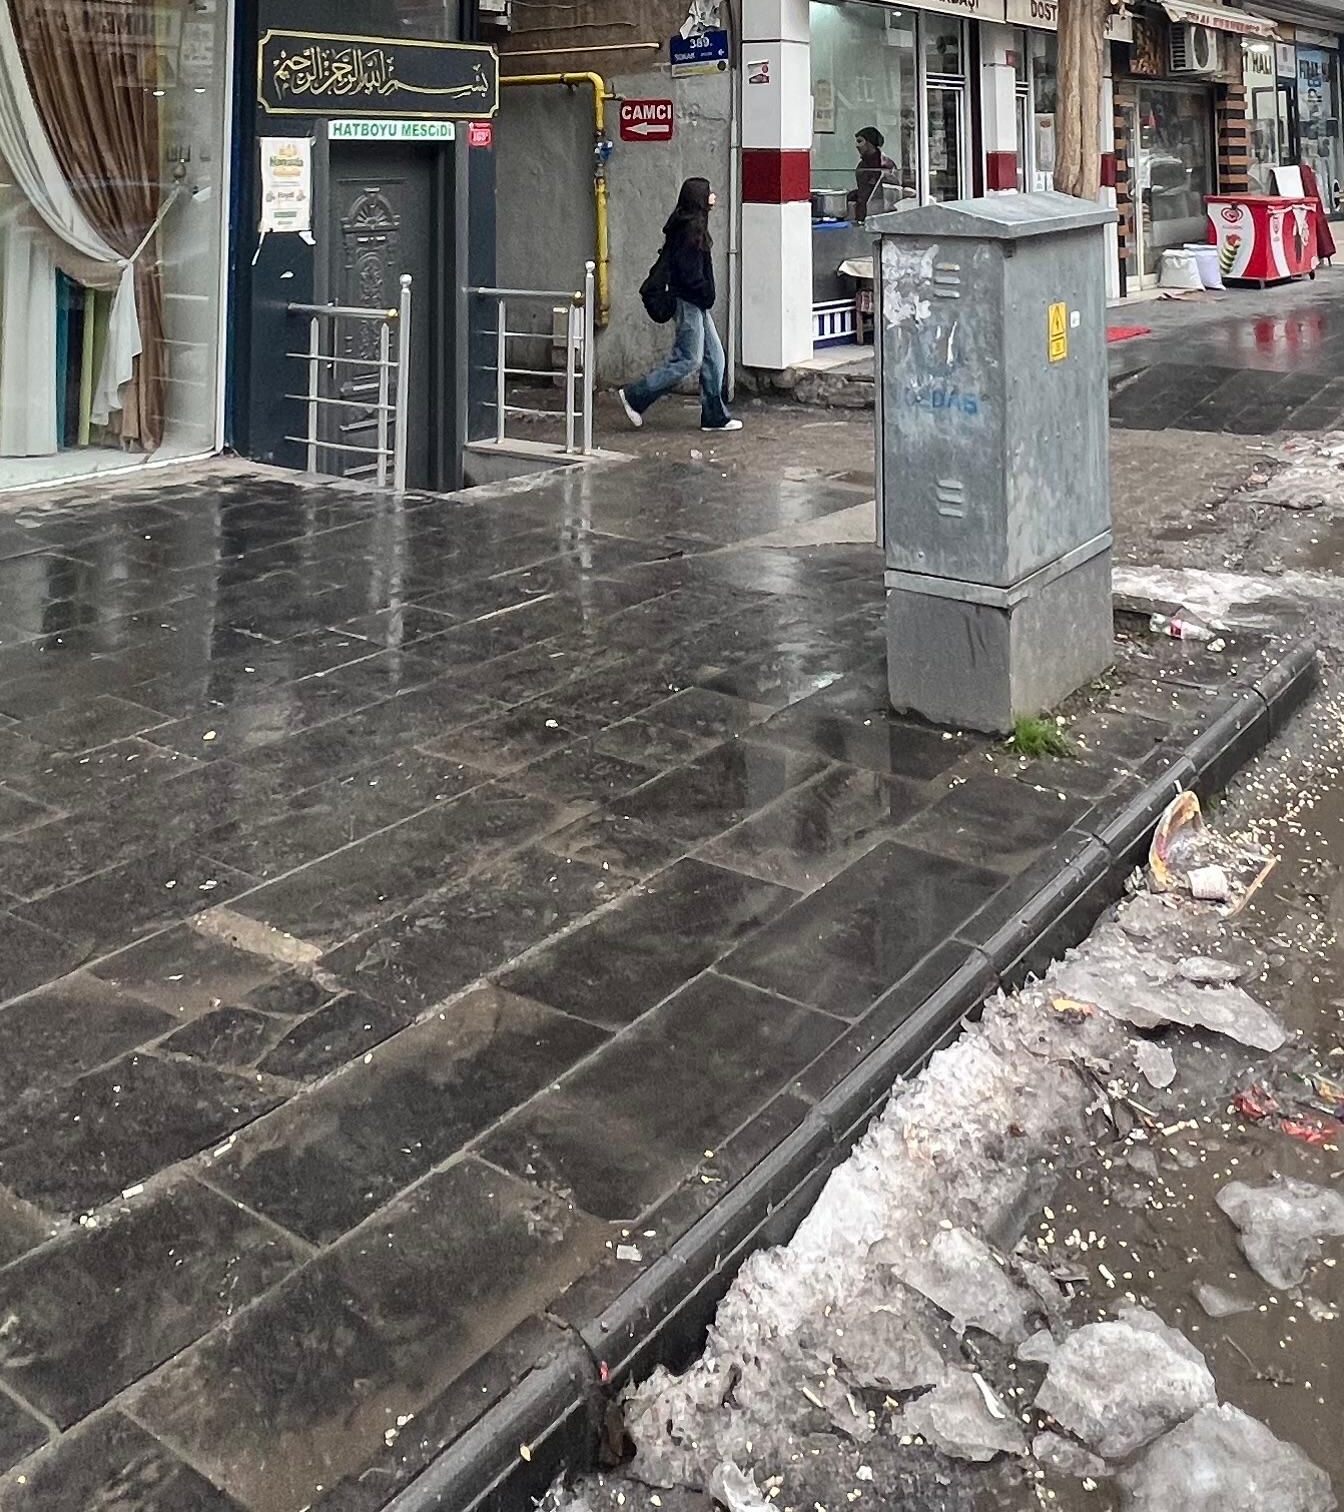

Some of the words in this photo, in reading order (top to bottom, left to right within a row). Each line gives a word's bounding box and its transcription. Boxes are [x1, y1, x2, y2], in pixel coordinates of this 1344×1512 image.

[1030, 0, 1057, 22] DOST
[621, 104, 672, 120] CAMCI
[333, 122, 397, 137] HATBOYU
